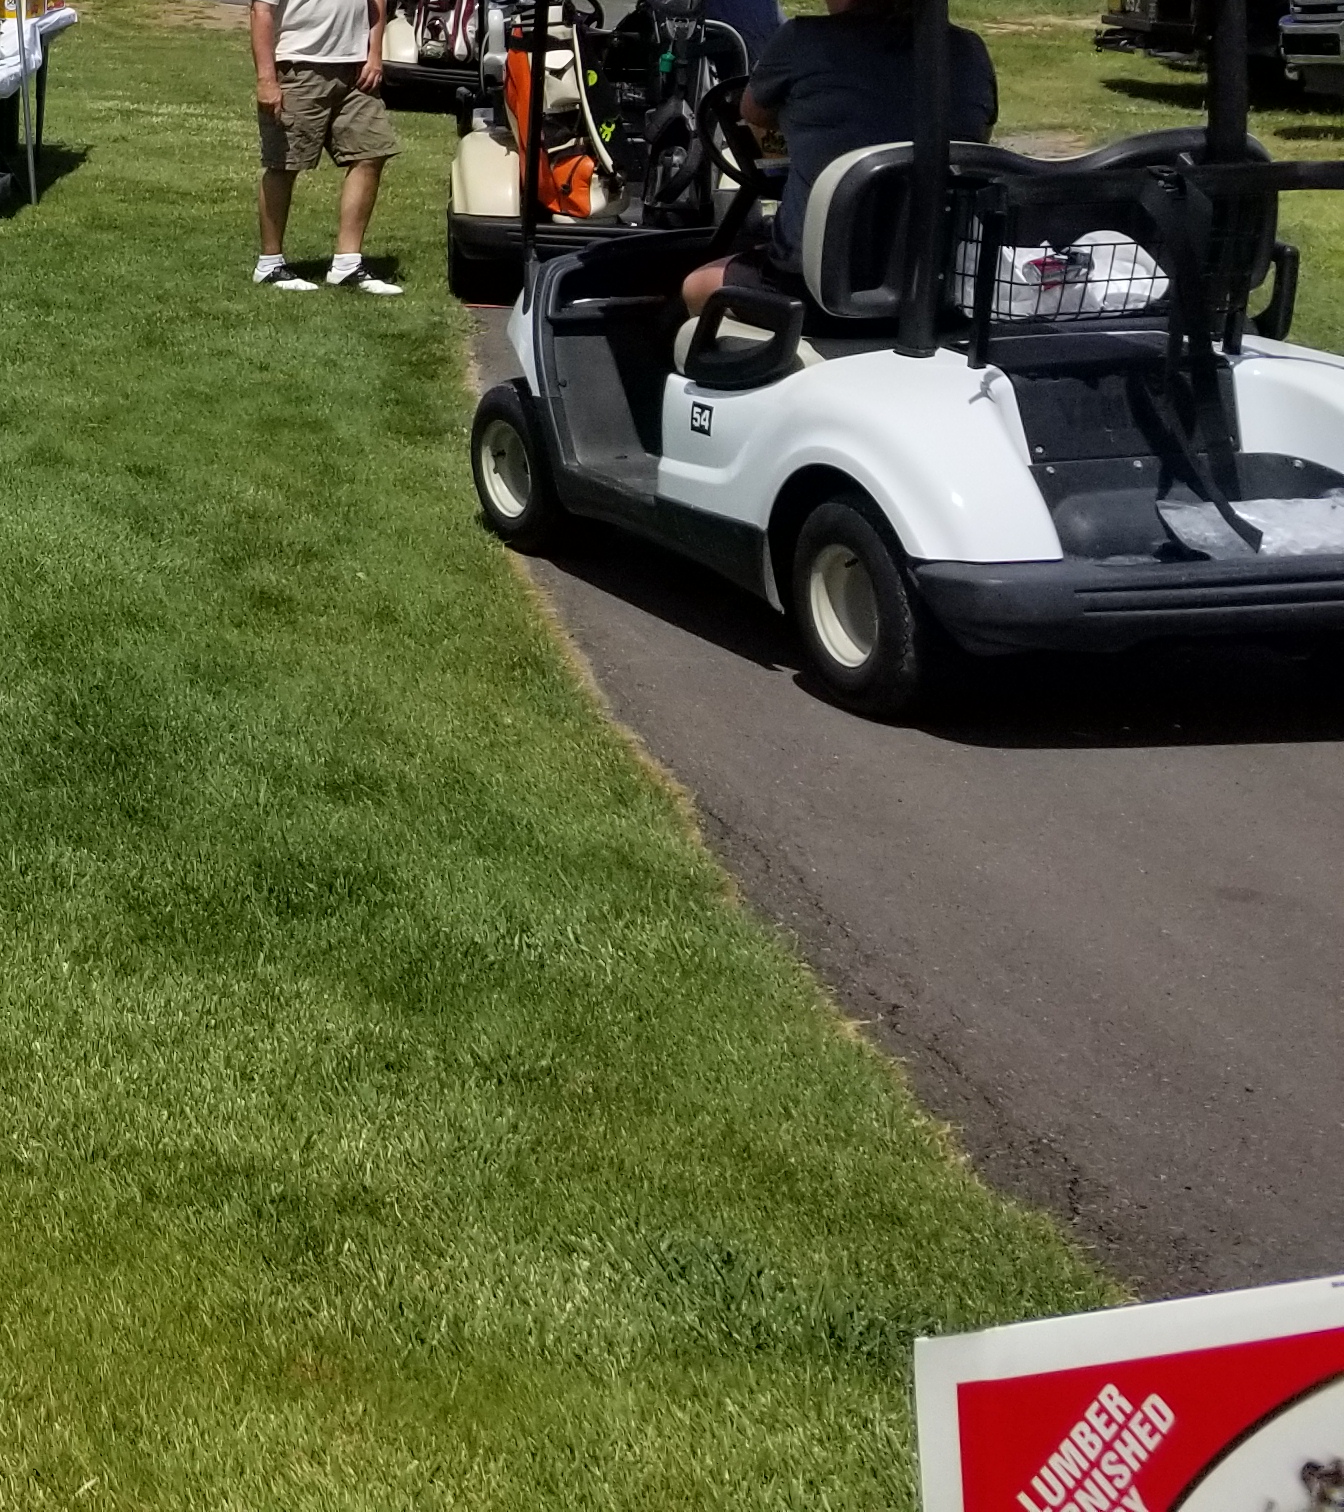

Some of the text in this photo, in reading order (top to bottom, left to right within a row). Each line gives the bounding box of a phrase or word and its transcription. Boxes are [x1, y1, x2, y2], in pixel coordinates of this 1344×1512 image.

[692, 406, 711, 431] 54
[1016, 1383, 1133, 1512] LUMBER
[1060, 1393, 1175, 1512] NISHED
